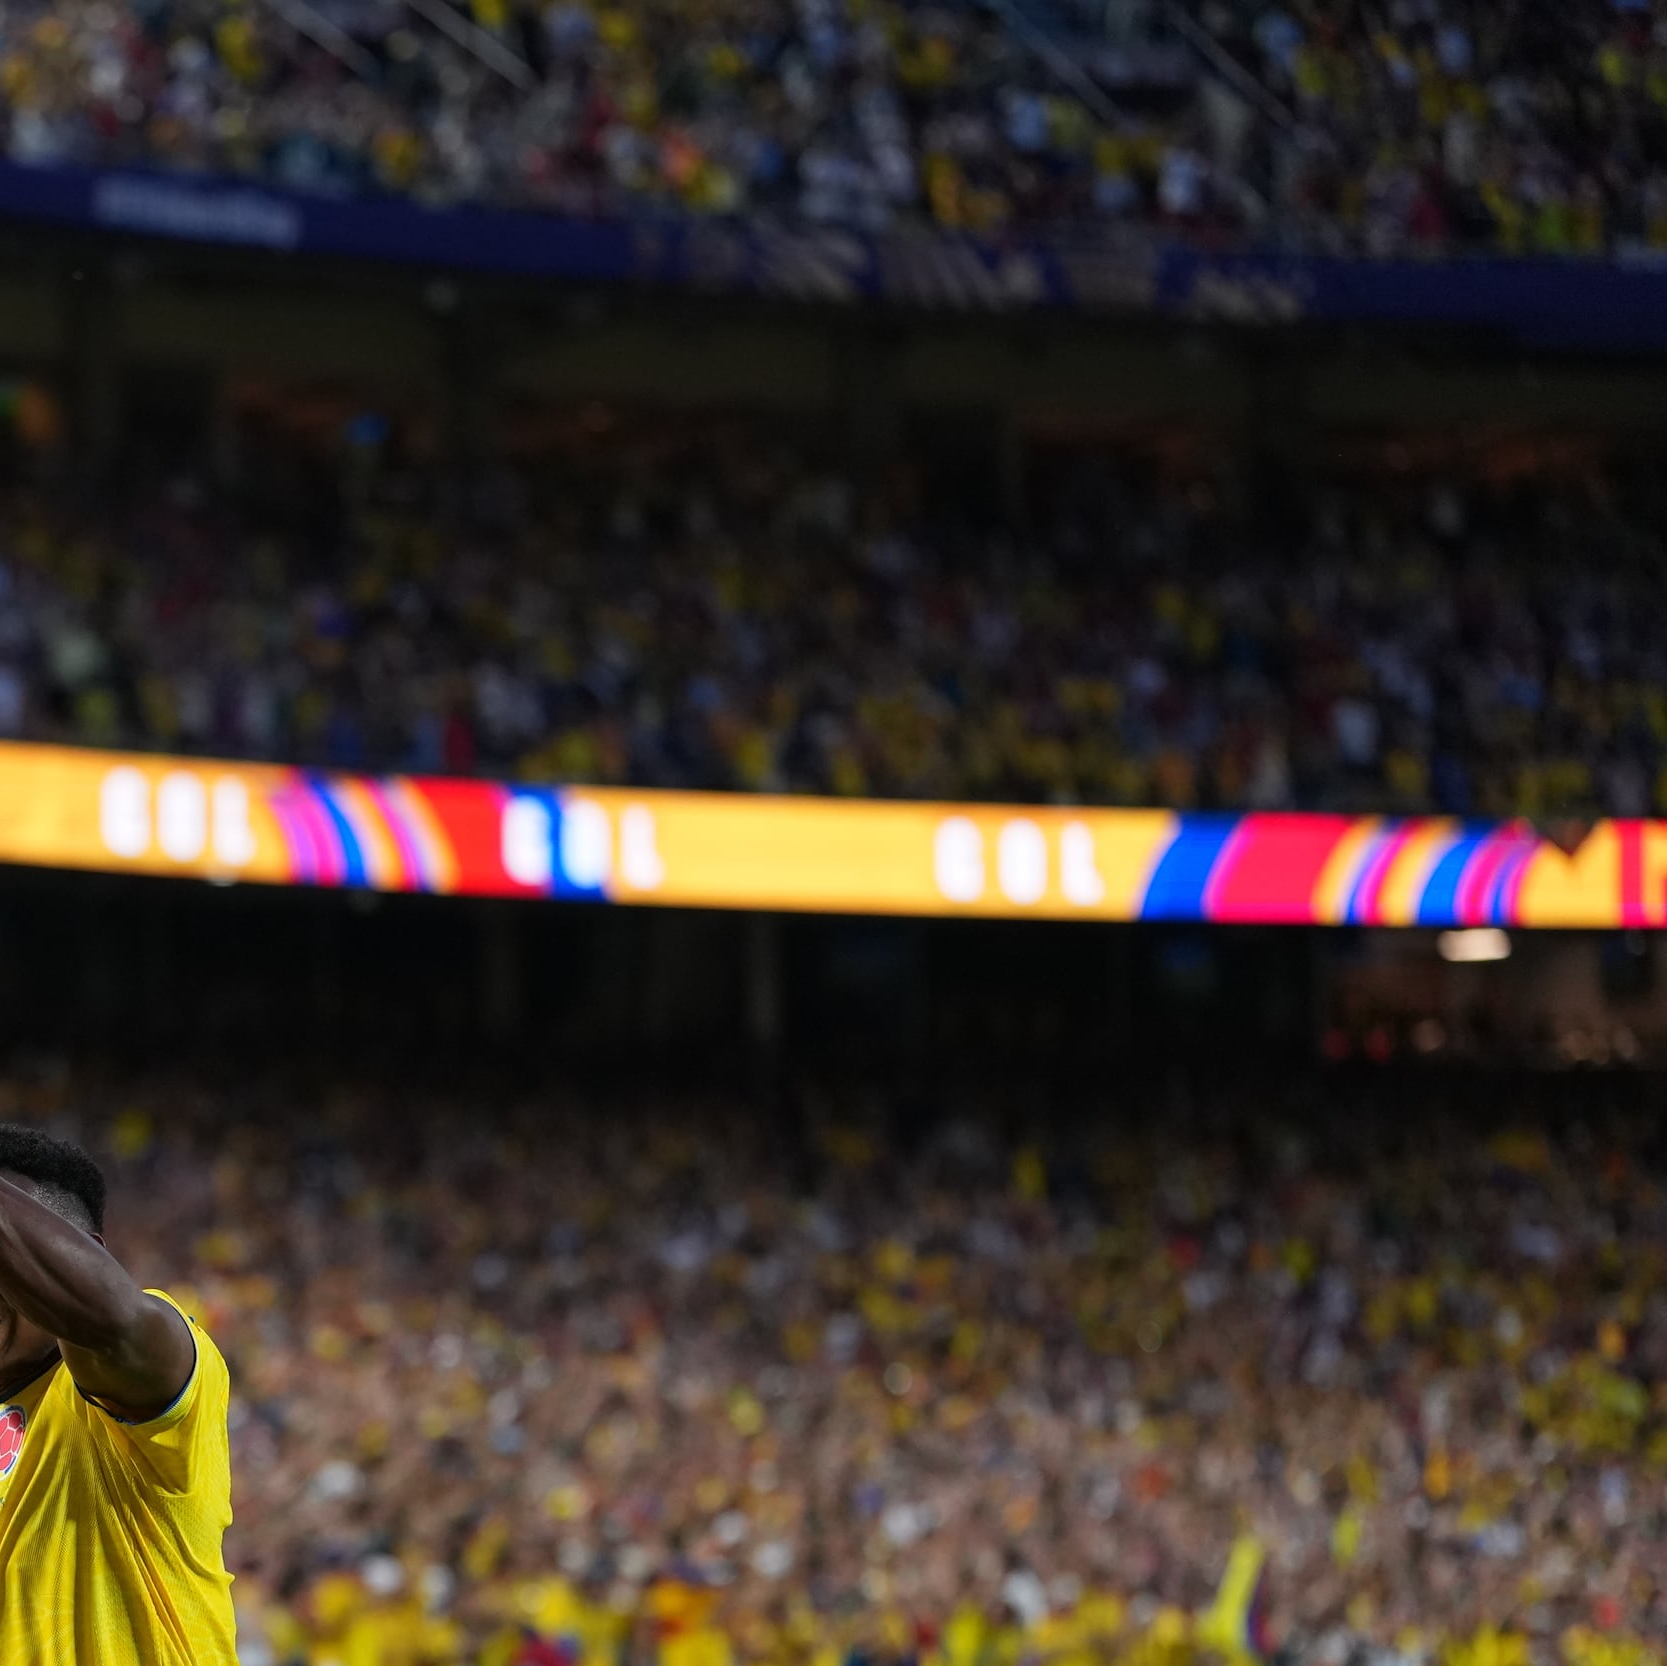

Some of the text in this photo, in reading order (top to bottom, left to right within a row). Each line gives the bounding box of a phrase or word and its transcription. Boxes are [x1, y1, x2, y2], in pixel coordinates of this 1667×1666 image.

[100, 765, 256, 866] GOL
[501, 794, 664, 890] GOL
[934, 816, 1106, 908] GOL
